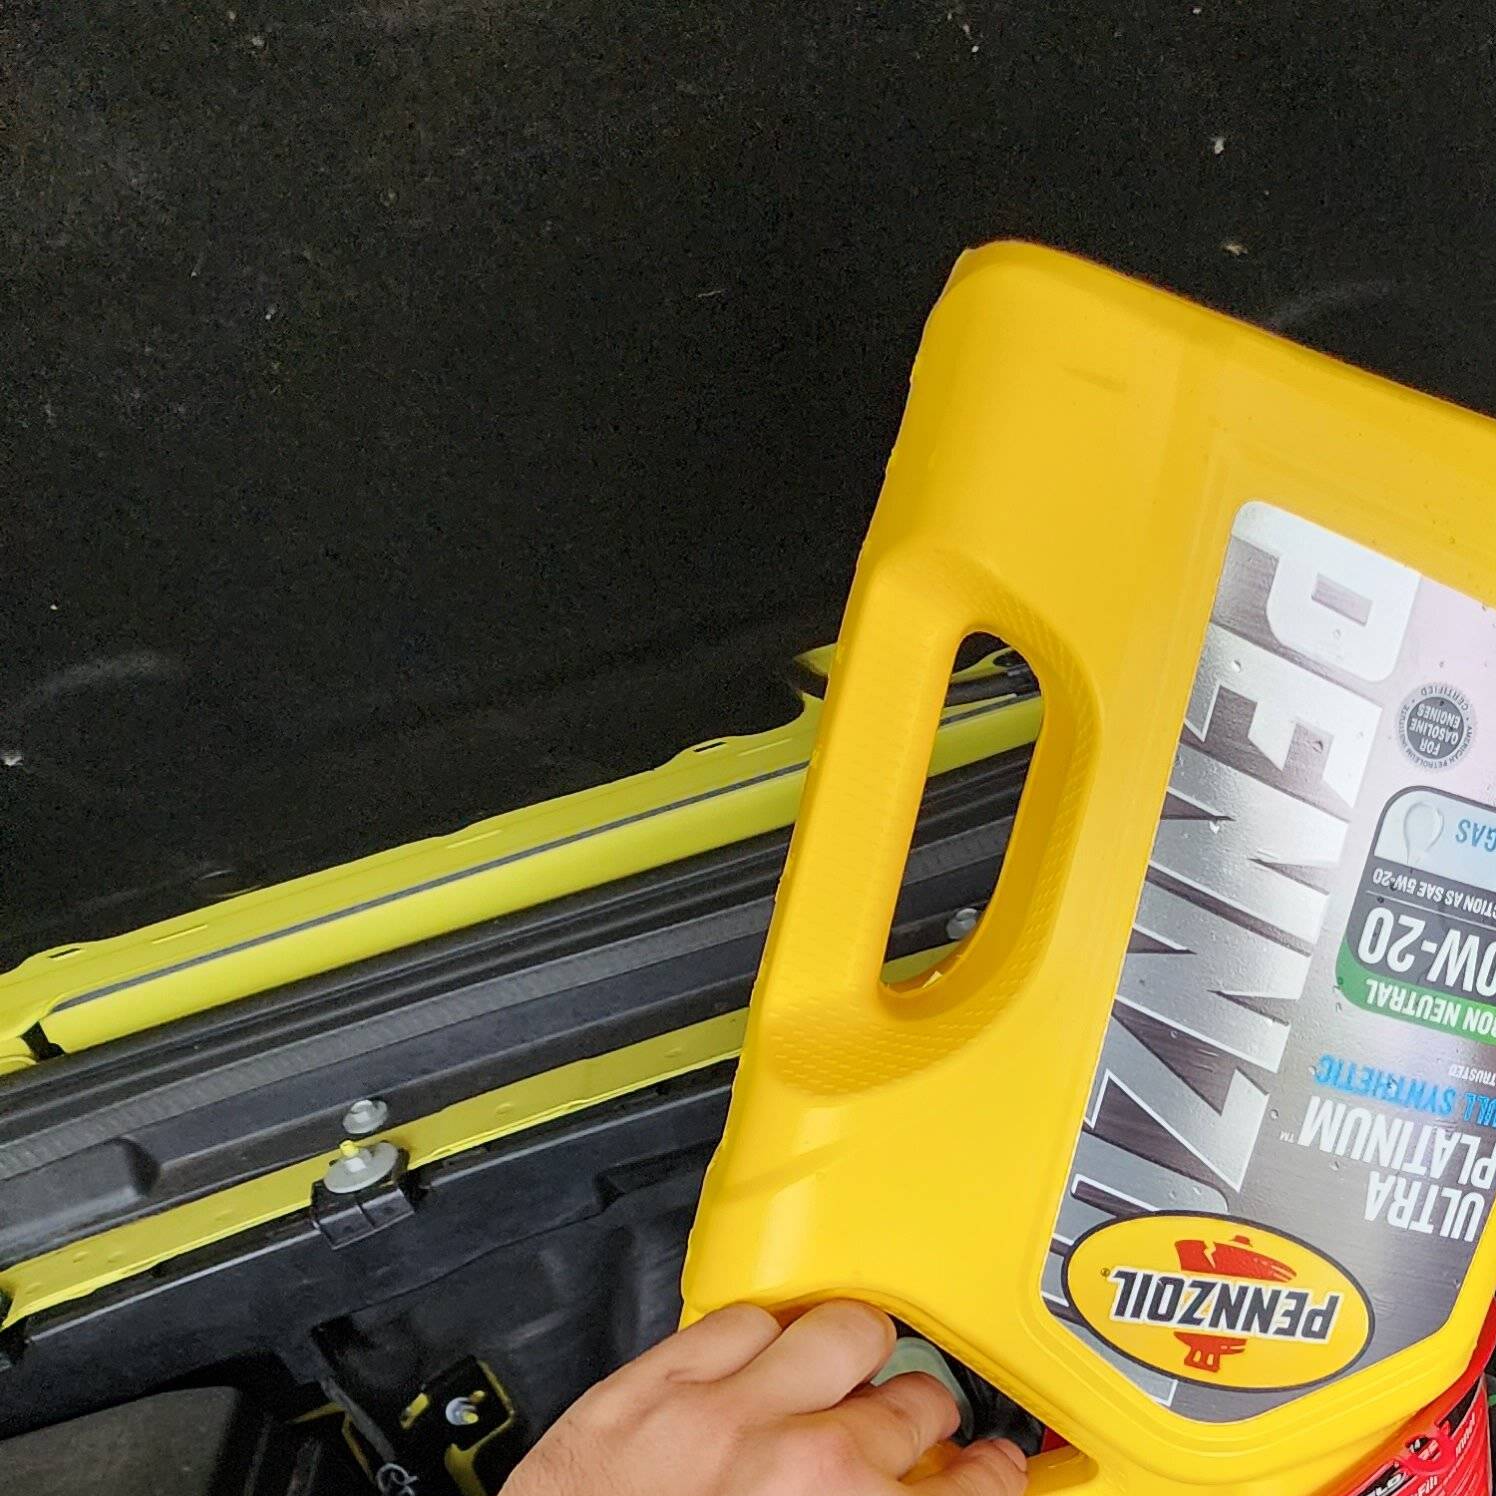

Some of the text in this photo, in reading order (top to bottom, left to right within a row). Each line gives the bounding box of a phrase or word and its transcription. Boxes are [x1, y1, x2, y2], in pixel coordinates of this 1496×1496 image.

[1416, 703, 1461, 730] ENGINES
[1409, 718, 1460, 744] GASOLINE
[1419, 738, 1441, 756] FOR
[1373, 867, 1416, 894] 5W-20
[1416, 884, 1442, 903] SAE
[1444, 892, 1462, 909] AS
[1366, 979, 1461, 1027] NEUTRAL
[1313, 1054, 1456, 1117] SYNTHETIC
[1448, 1064, 1496, 1086] TRUSTED
[1363, 1170, 1485, 1243] ULTRA
[1112, 1269, 1342, 1341] PENNZOIL
